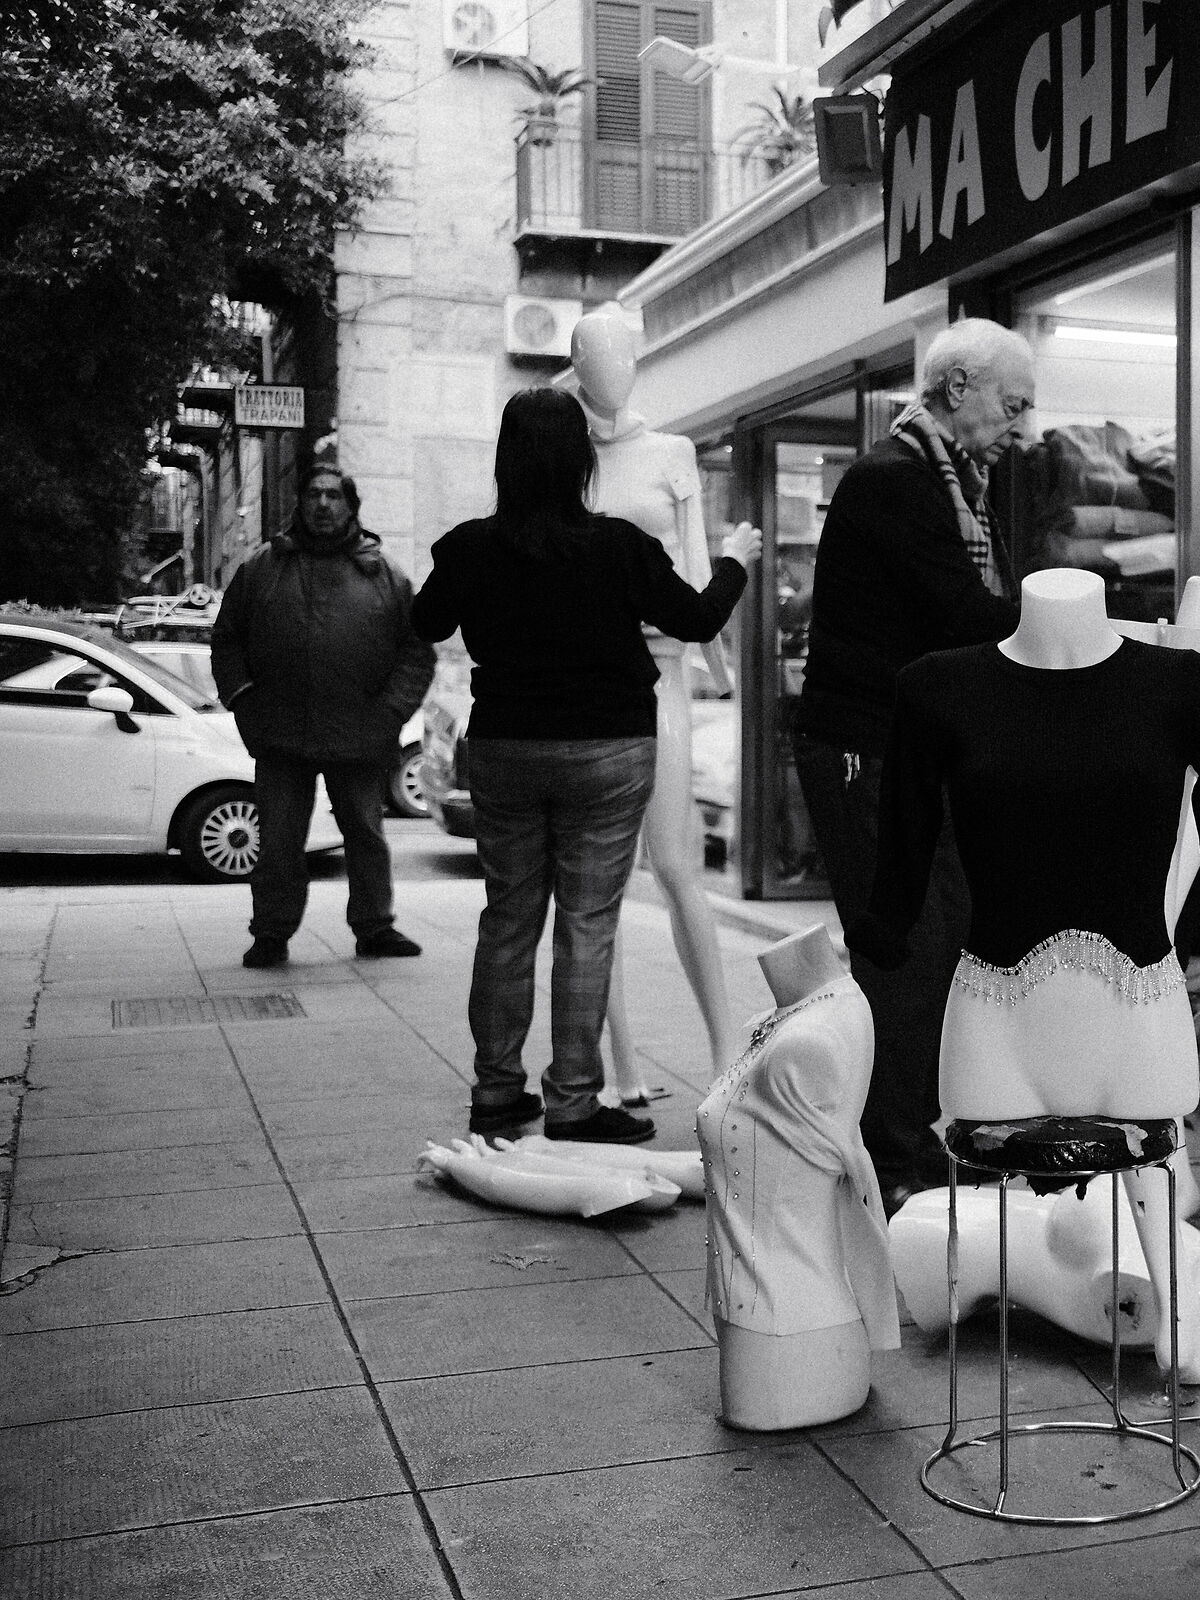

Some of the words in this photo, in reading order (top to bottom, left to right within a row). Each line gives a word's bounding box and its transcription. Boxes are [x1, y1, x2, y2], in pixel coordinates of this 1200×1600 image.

[886, 78, 986, 267] MA
[1014, 0, 1174, 202] CHE
[237, 388, 303, 408] TRATTORIA
